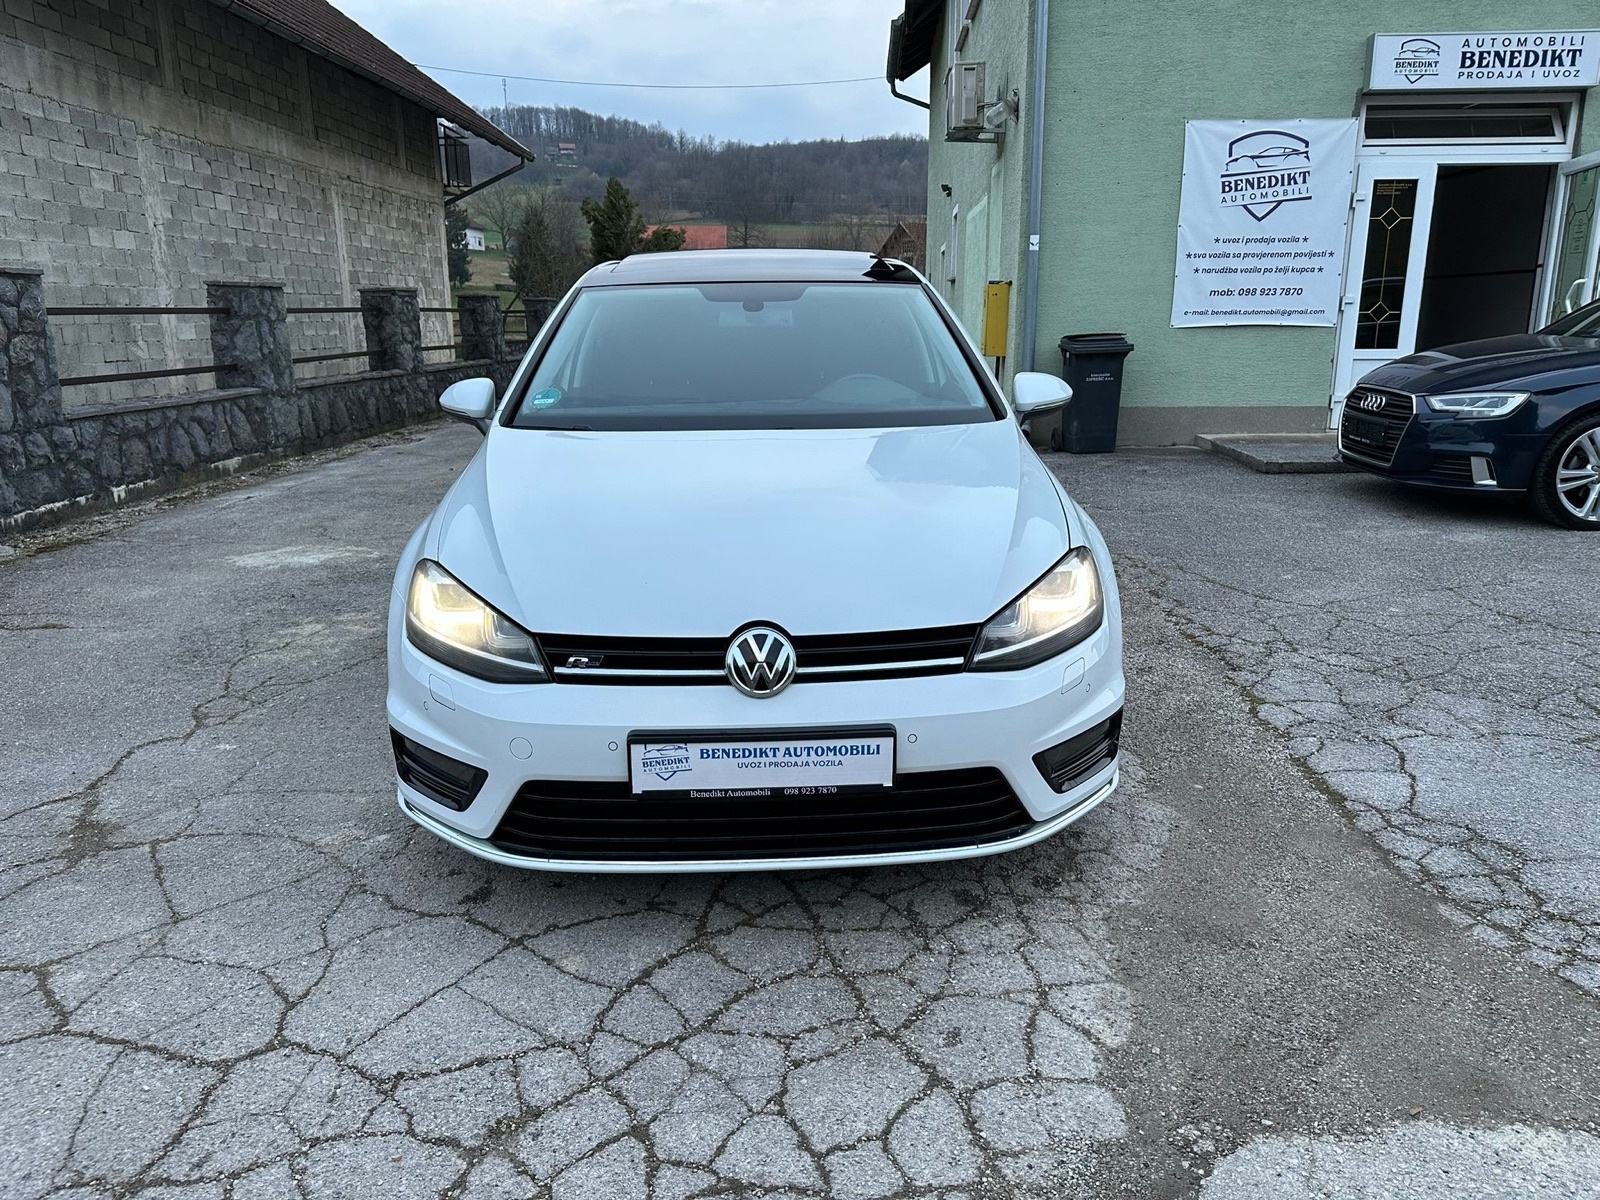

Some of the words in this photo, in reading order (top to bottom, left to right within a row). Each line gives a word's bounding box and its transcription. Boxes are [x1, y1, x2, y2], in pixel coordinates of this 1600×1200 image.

[1461, 36, 1585, 48] AUTOMOBILI
[1395, 60, 1440, 68] BENEDIKT
[1459, 48, 1583, 69] BENEDIKT
[1458, 70, 1523, 79] PRODAJA
[1542, 69, 1581, 78] UVOZ
[1221, 171, 1311, 194] BENEDIKT
[1221, 187, 1309, 204] AUTOMOBILI
[1245, 236, 1276, 246] prodaja
[1277, 235, 1300, 243] vozila
[1193, 251, 1207, 259] sva
[1208, 251, 1231, 259] vozila
[1242, 250, 1293, 260] provjerenom
[1293, 249, 1328, 260] povijesti
[1201, 265, 1238, 274] narudžba
[1239, 265, 1262, 274] vozila
[1263, 267, 1274, 275] po
[1274, 265, 1290, 275] želji
[1291, 266, 1316, 275] kupca
[1209, 288, 1236, 297] mob:
[1238, 288, 1257, 297] 098
[1259, 287, 1277, 296] 923
[1280, 287, 1304, 296] 7870
[1211, 308, 1326, 317] benedikt.automobili@gmail.com
[700, 748, 780, 760] BENEDIKT
[783, 744, 881, 758] AUTOMOBILI
[642, 756, 690, 768] BENEDIKT
[737, 761, 763, 769] UVOZ
[768, 760, 810, 769] PRODAJA
[812, 759, 844, 768] VOZILA
[690, 789, 725, 798] Benedikt
[726, 788, 771, 797] Automobili
[784, 787, 800, 796] 098
[801, 786, 817, 795] 923
[818, 786, 837, 795] 7870
